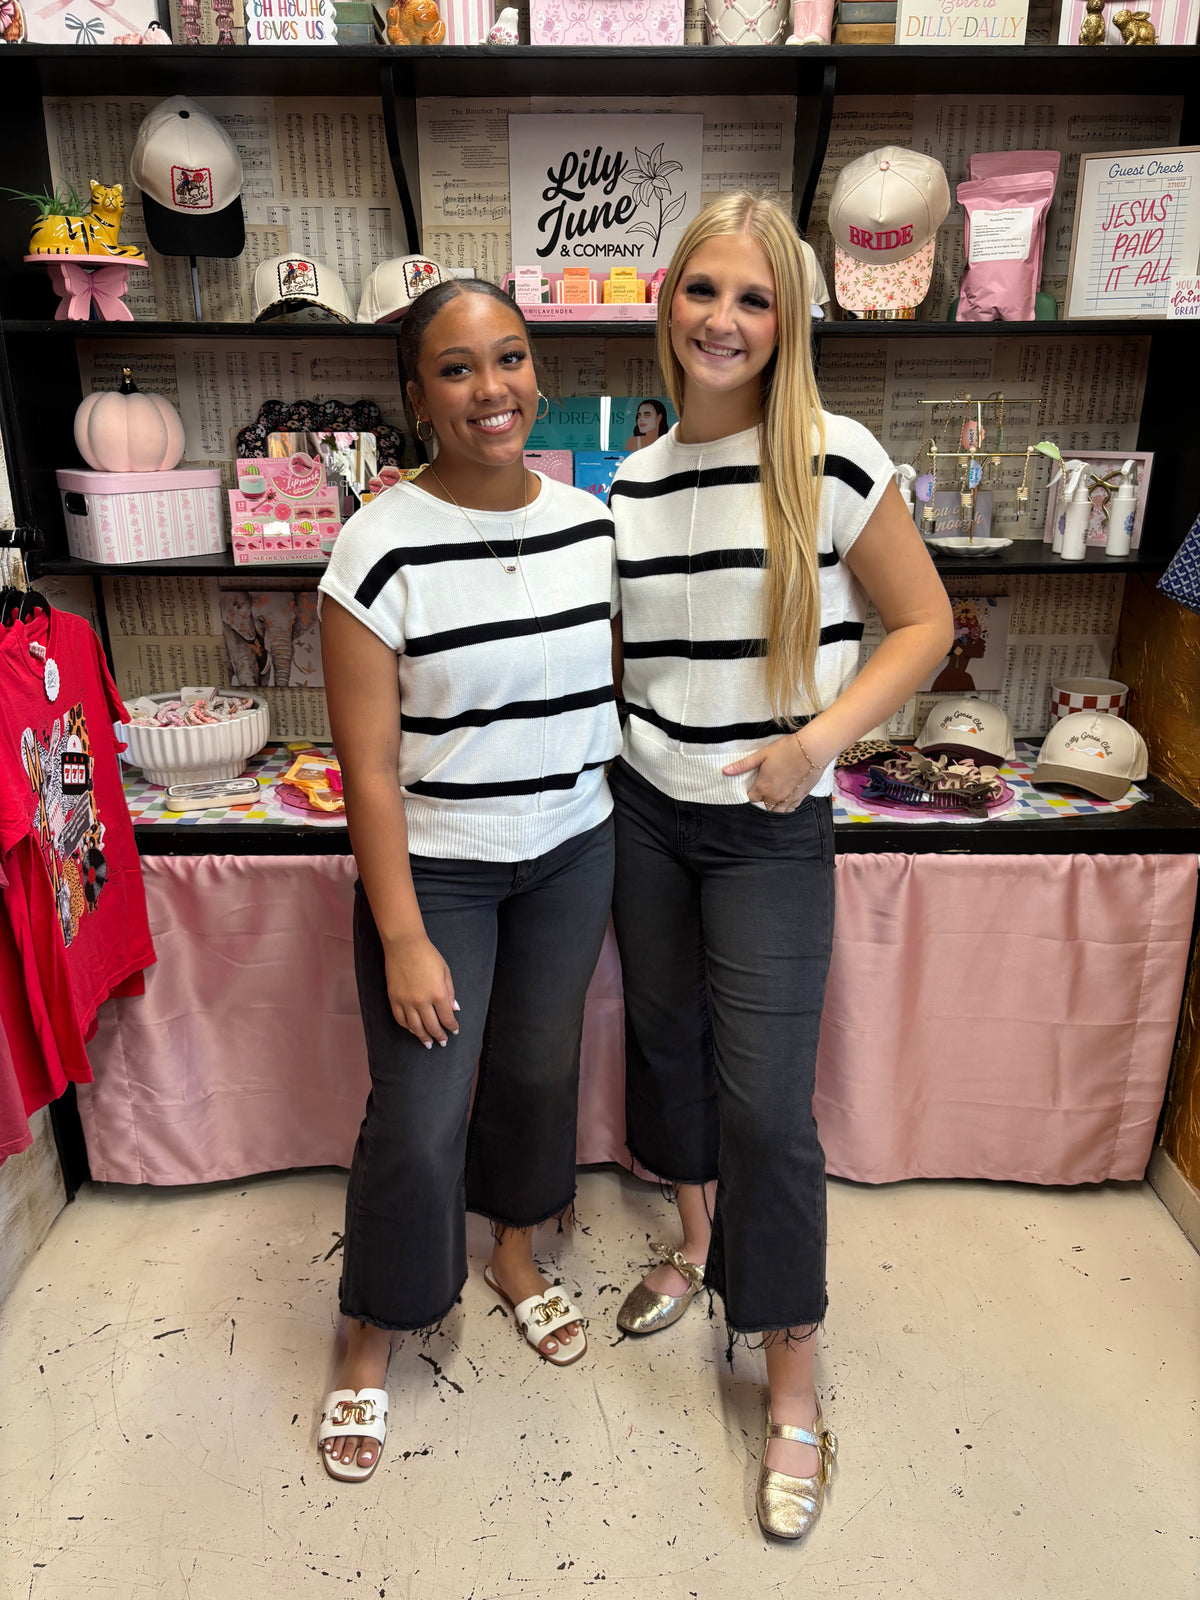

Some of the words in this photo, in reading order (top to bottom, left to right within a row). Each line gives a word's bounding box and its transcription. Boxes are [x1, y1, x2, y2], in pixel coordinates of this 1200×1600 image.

[254, 0, 273, 17] OH
[278, 0, 307, 17] HOW
[305, 20, 324, 40] US
[905, 15, 1025, 38] DILLY-DALLY
[542, 146, 629, 202] Lily
[1108, 163, 1145, 178] Guest
[1147, 160, 1184, 176] Check
[1102, 194, 1173, 231] JESUS
[536, 199, 638, 258] June
[849, 224, 914, 250] BRIDE
[560, 244, 571, 257] &
[573, 244, 645, 257] COMPANY
[1112, 228, 1164, 262] PAID
[1104, 265, 1129, 293] IT
[1134, 256, 1172, 288] ALL
[1176, 280, 1193, 290] YOU
[1175, 306, 1199, 316] GREAT
[559, 411, 624, 424] DREAS
[936, 512, 984, 532] nough
